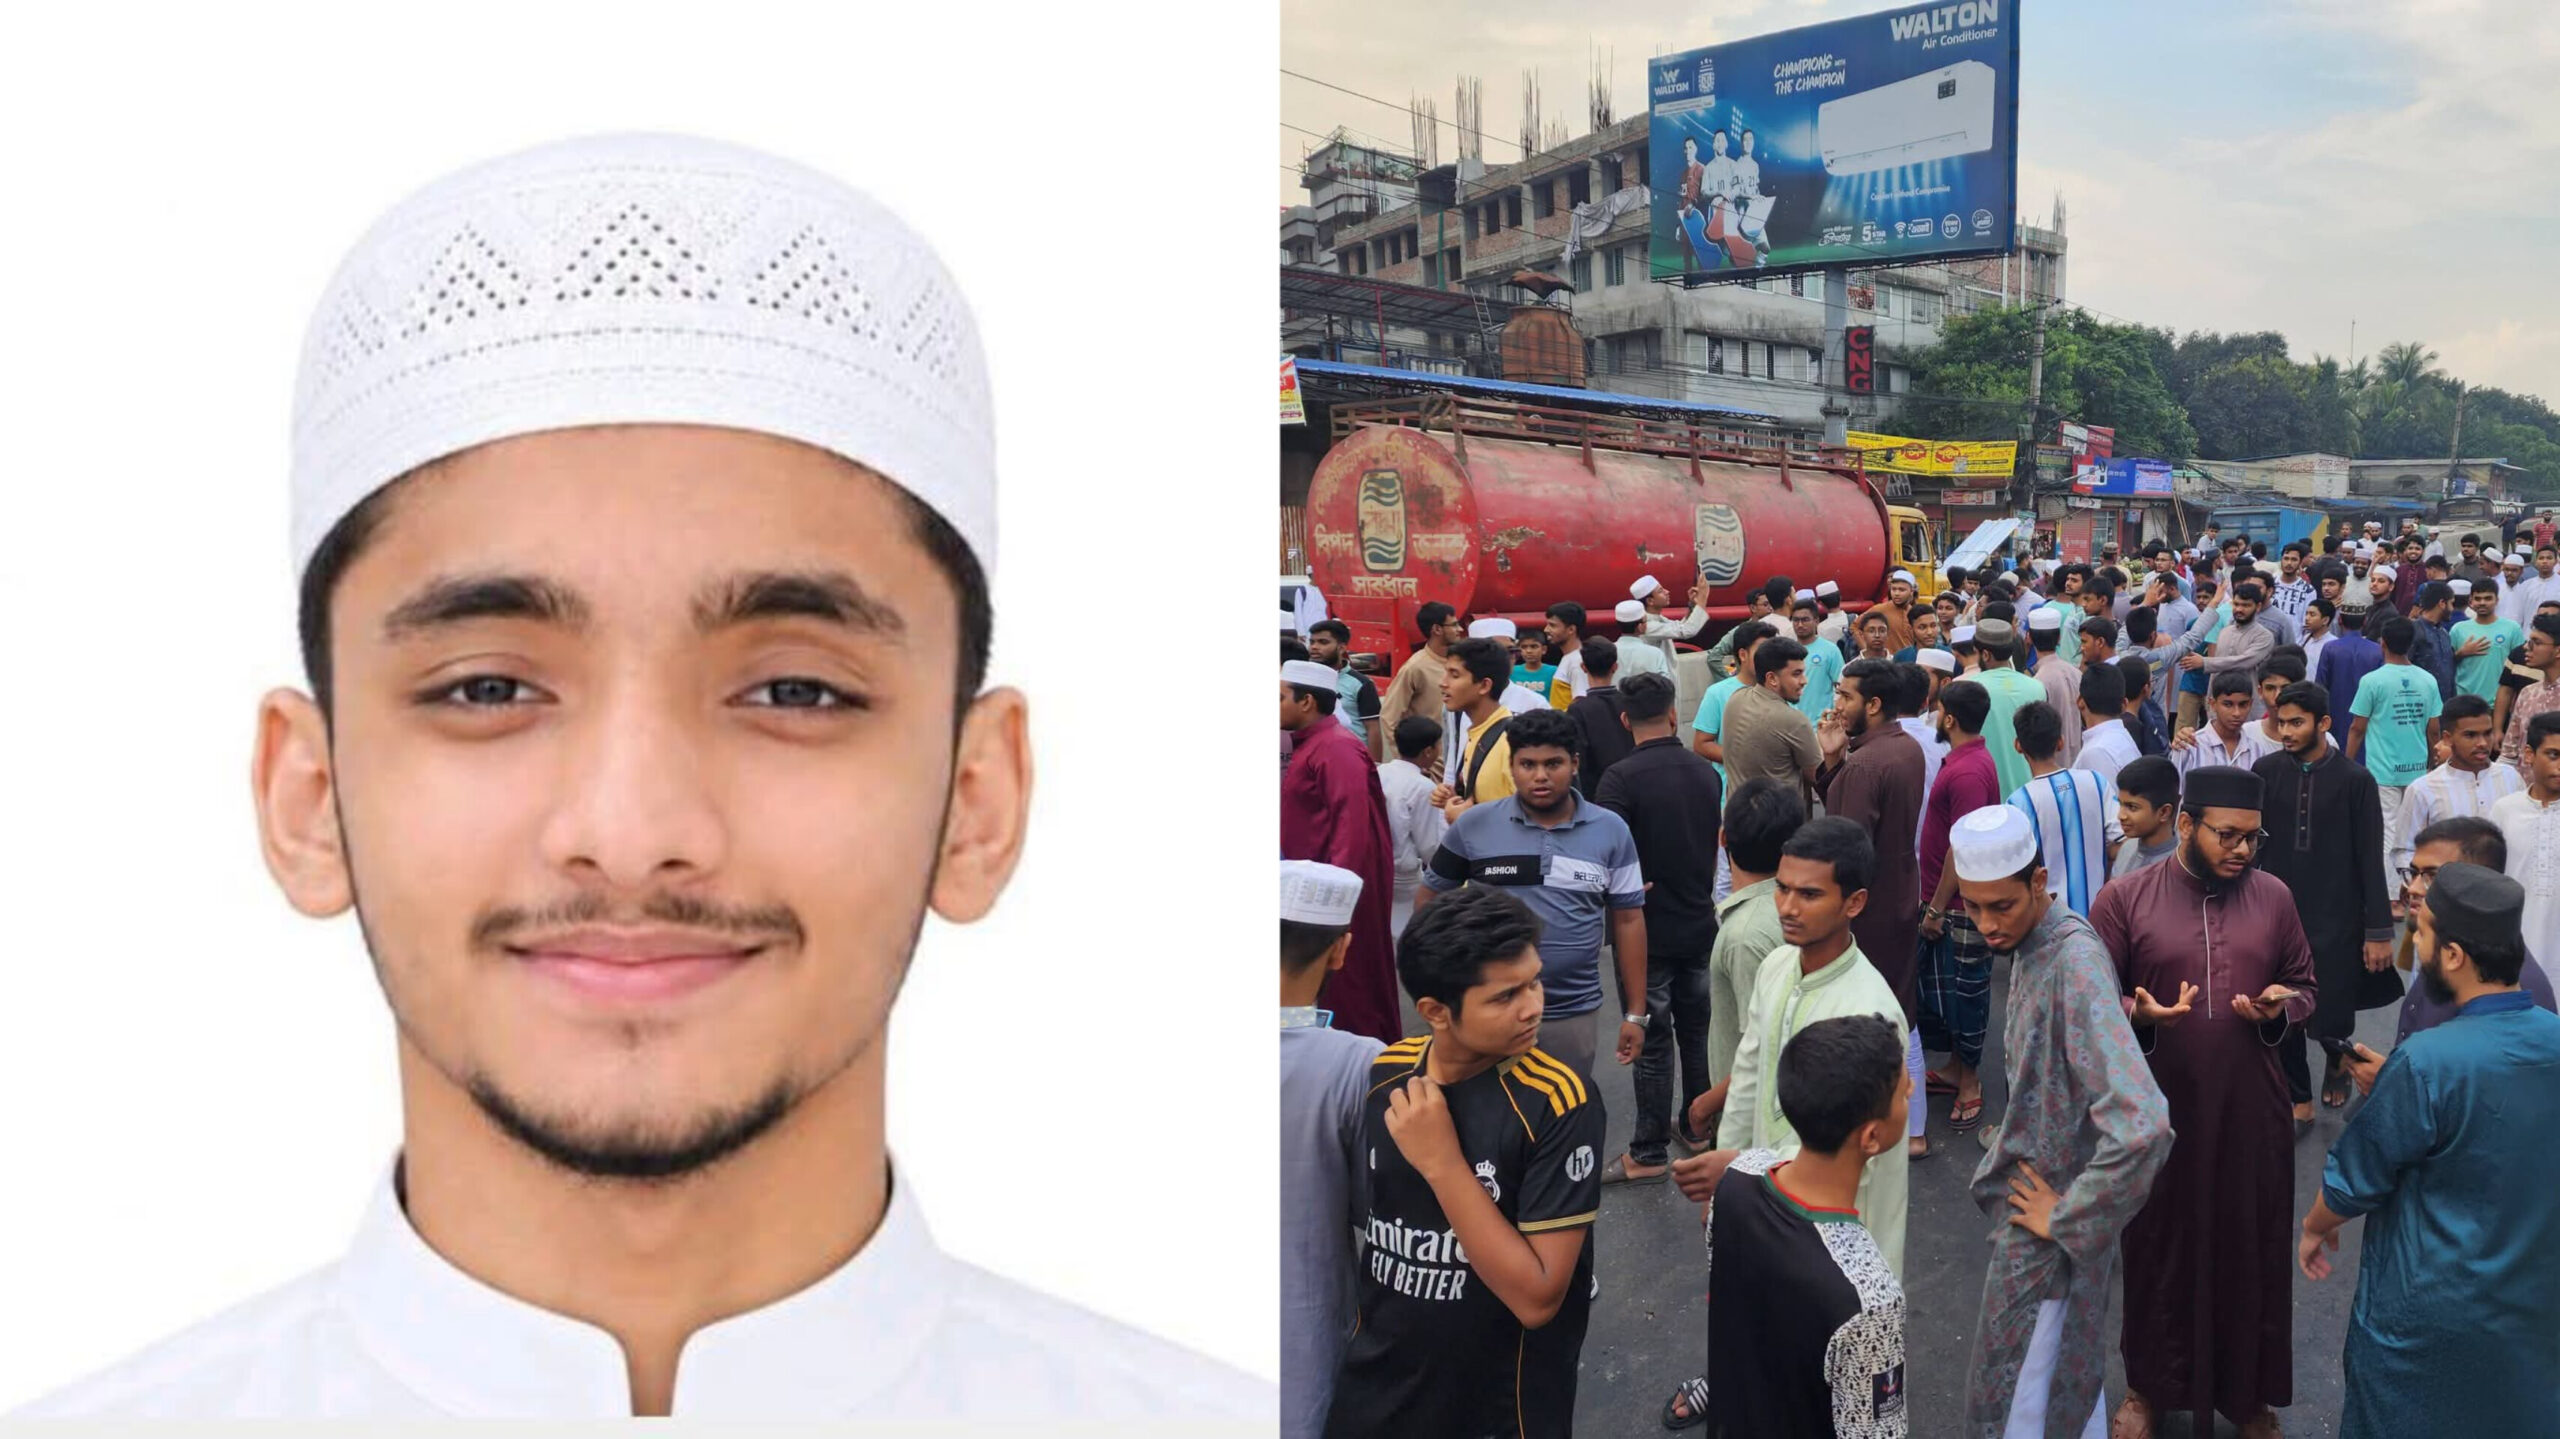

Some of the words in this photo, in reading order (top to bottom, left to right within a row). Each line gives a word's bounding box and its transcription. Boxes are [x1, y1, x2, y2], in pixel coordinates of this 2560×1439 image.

[1890, 0, 1999, 42] WALTON
[1922, 38, 1938, 51] Air
[1940, 27, 1998, 46] Conditioner
[1774, 52, 1833, 79] CHAMPIONS
[1654, 81, 1689, 97] WALTON
[1774, 79, 1794, 95] THE
[1795, 68, 1846, 92] CHAMPION
[1848, 327, 1871, 391] CNG
[1351, 573, 1419, 598] সাবধান
[1484, 865, 1518, 875] FASHION
[1371, 1250, 1394, 1287] FLY
[1393, 1258, 1467, 1301] BETTER
